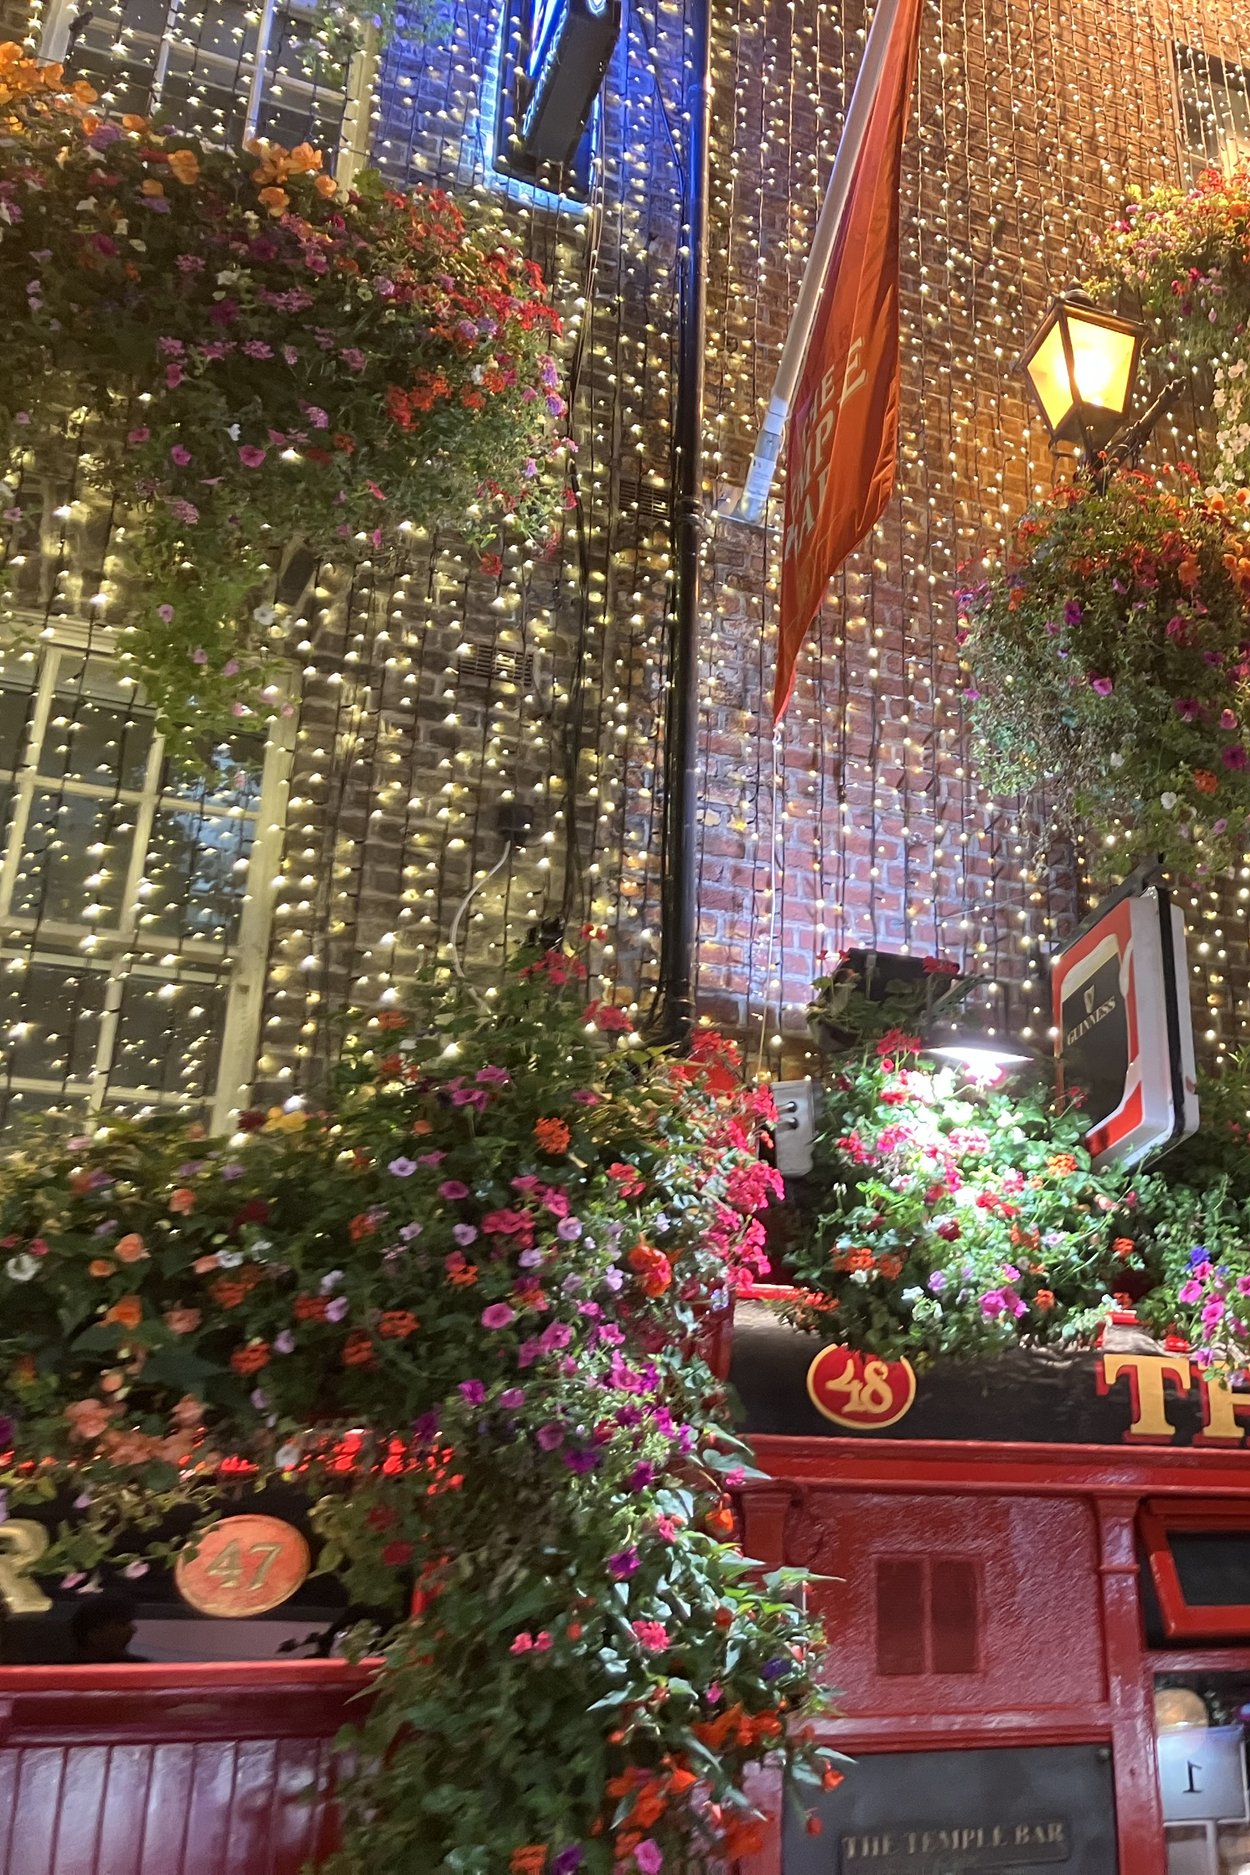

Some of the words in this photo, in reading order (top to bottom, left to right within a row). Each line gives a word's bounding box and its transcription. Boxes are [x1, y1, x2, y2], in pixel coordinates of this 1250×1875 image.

[1066, 995, 1118, 1047] GUINNESS
[825, 1359, 894, 1415] 48
[205, 1538, 284, 1591] 47
[1014, 1822, 1065, 1845] BAR
